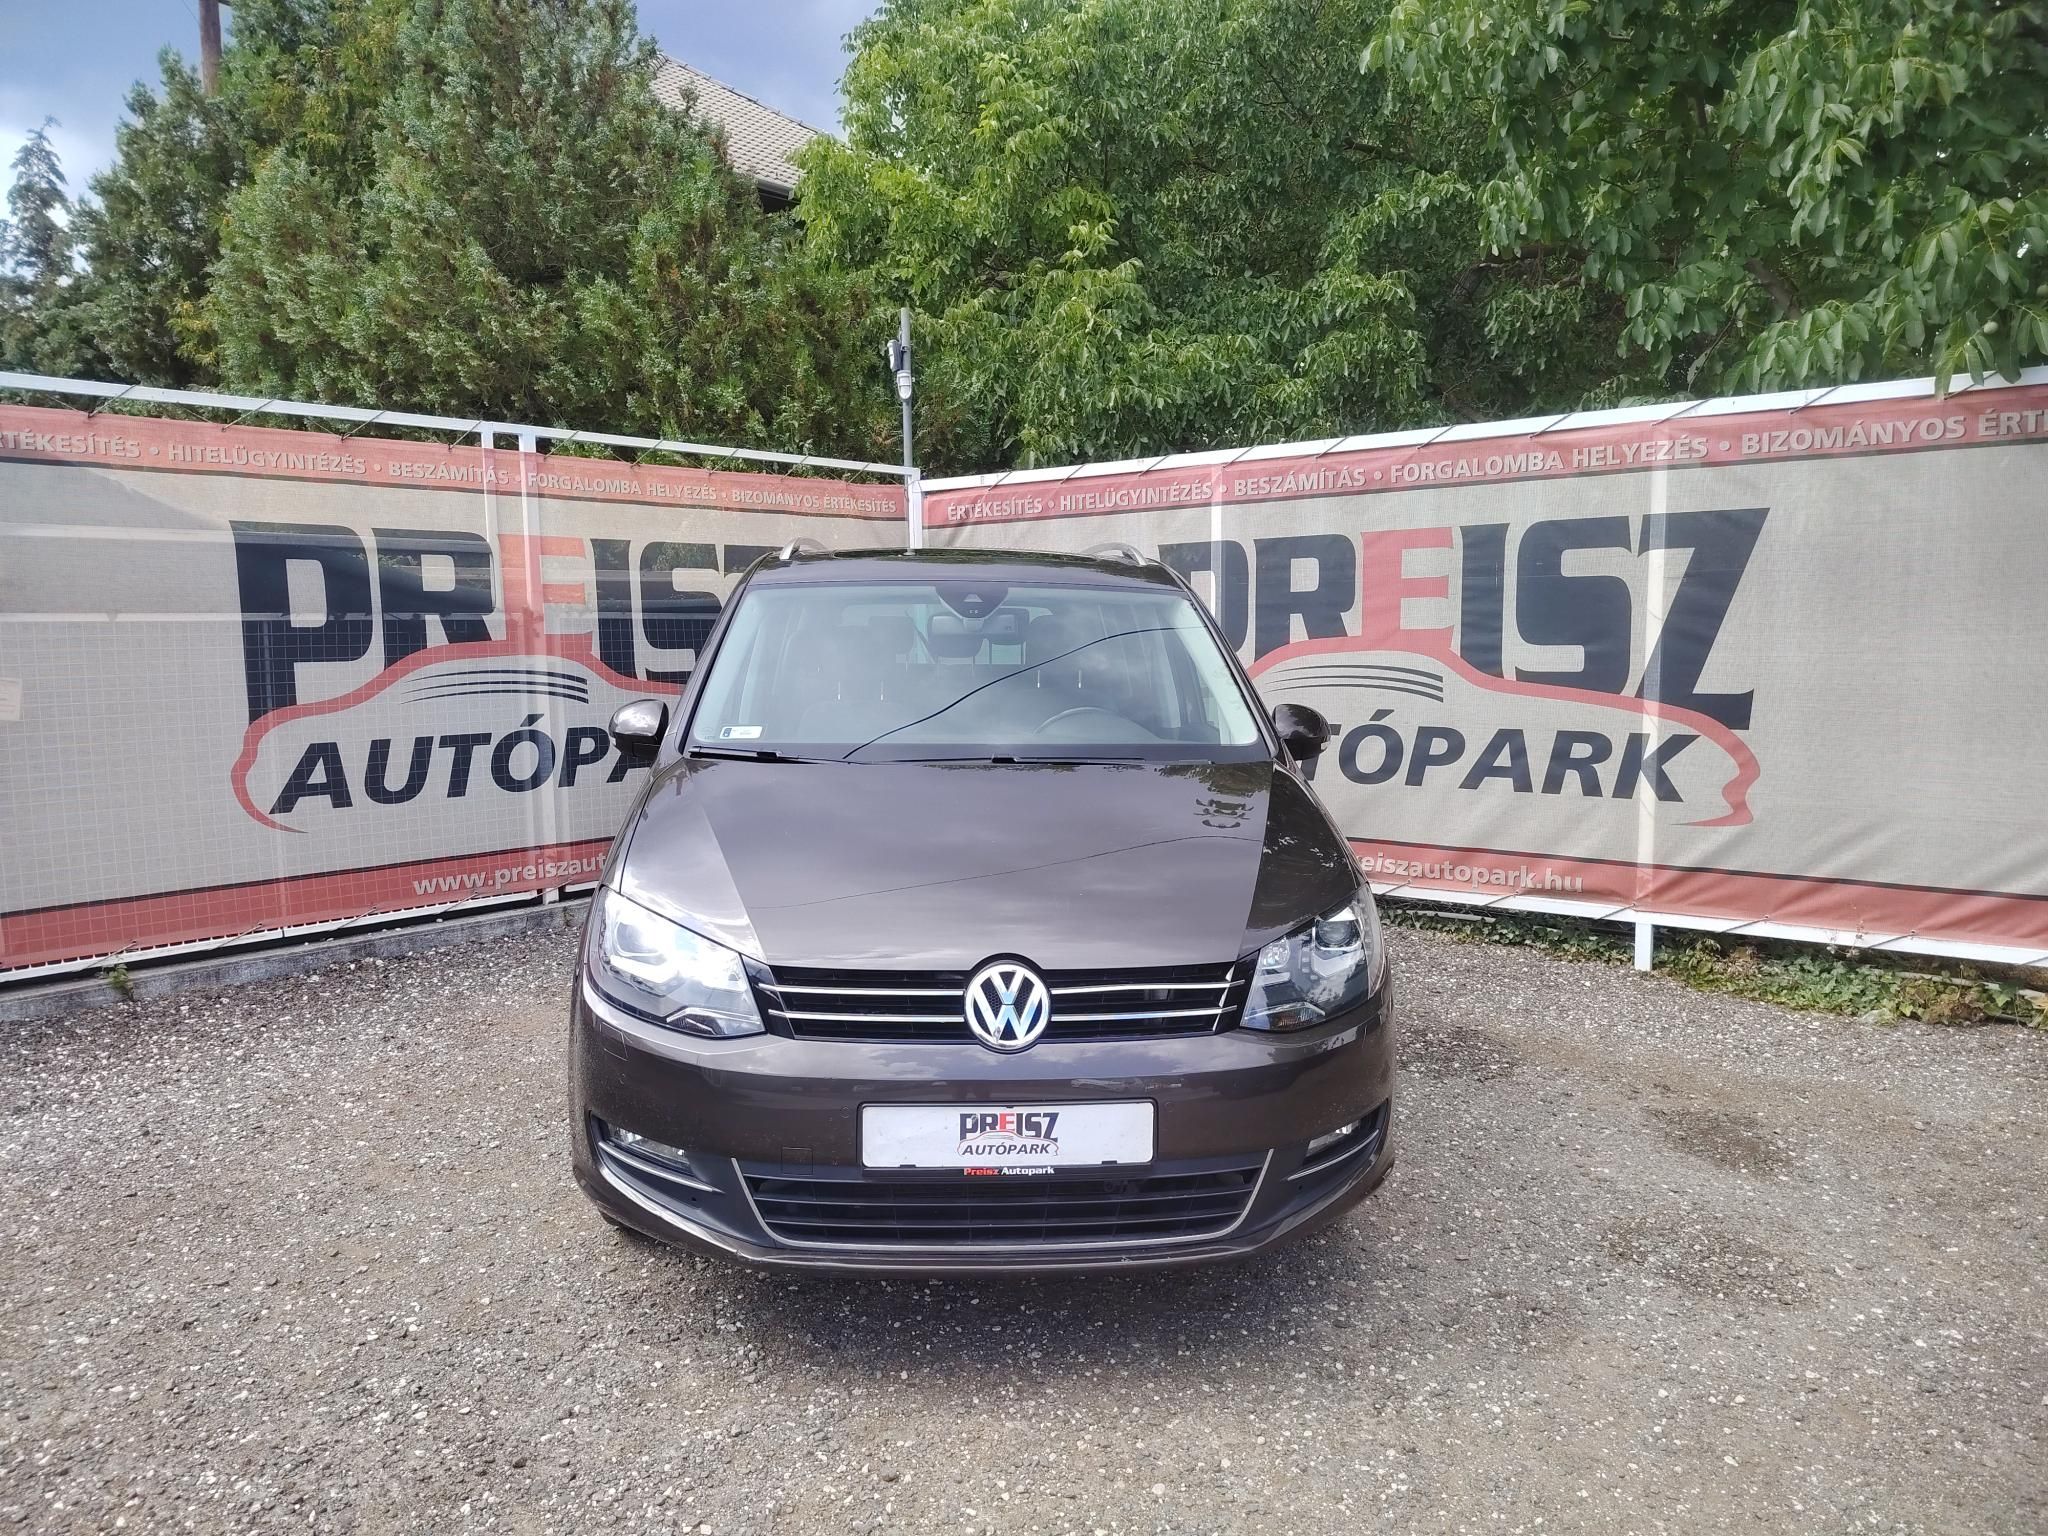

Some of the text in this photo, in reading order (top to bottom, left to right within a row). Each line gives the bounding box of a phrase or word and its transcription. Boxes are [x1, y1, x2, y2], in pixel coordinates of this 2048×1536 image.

[168, 444, 367, 475] HITELÜGYINTÉZÉS
[390, 463, 510, 486] BESZÁMÍTÁS
[528, 472, 642, 496] FORGALOMBA
[647, 482, 717, 501] HELYEZÉS
[732, 490, 820, 510] BIZOMÁNYOS
[823, 494, 897, 513] ÉRTÉKESÍTÉS
[947, 498, 1043, 521] ÉRTÉKESÍTÉS
[1060, 481, 1213, 512] HITELÜGYINTÉZÉS
[1234, 466, 1367, 496] BESZÁMÍTÁS
[1391, 449, 1564, 483] FORGALOMBA
[1572, 436, 1708, 468] HELYEZÉS
[1741, 414, 1967, 455] BIZOMÁNYOS
[959, 1112, 1059, 1142] PREISZ
[962, 1142, 1051, 1155] AUTÓPARK
[963, 1166, 1055, 1176] Preisz Autopark
